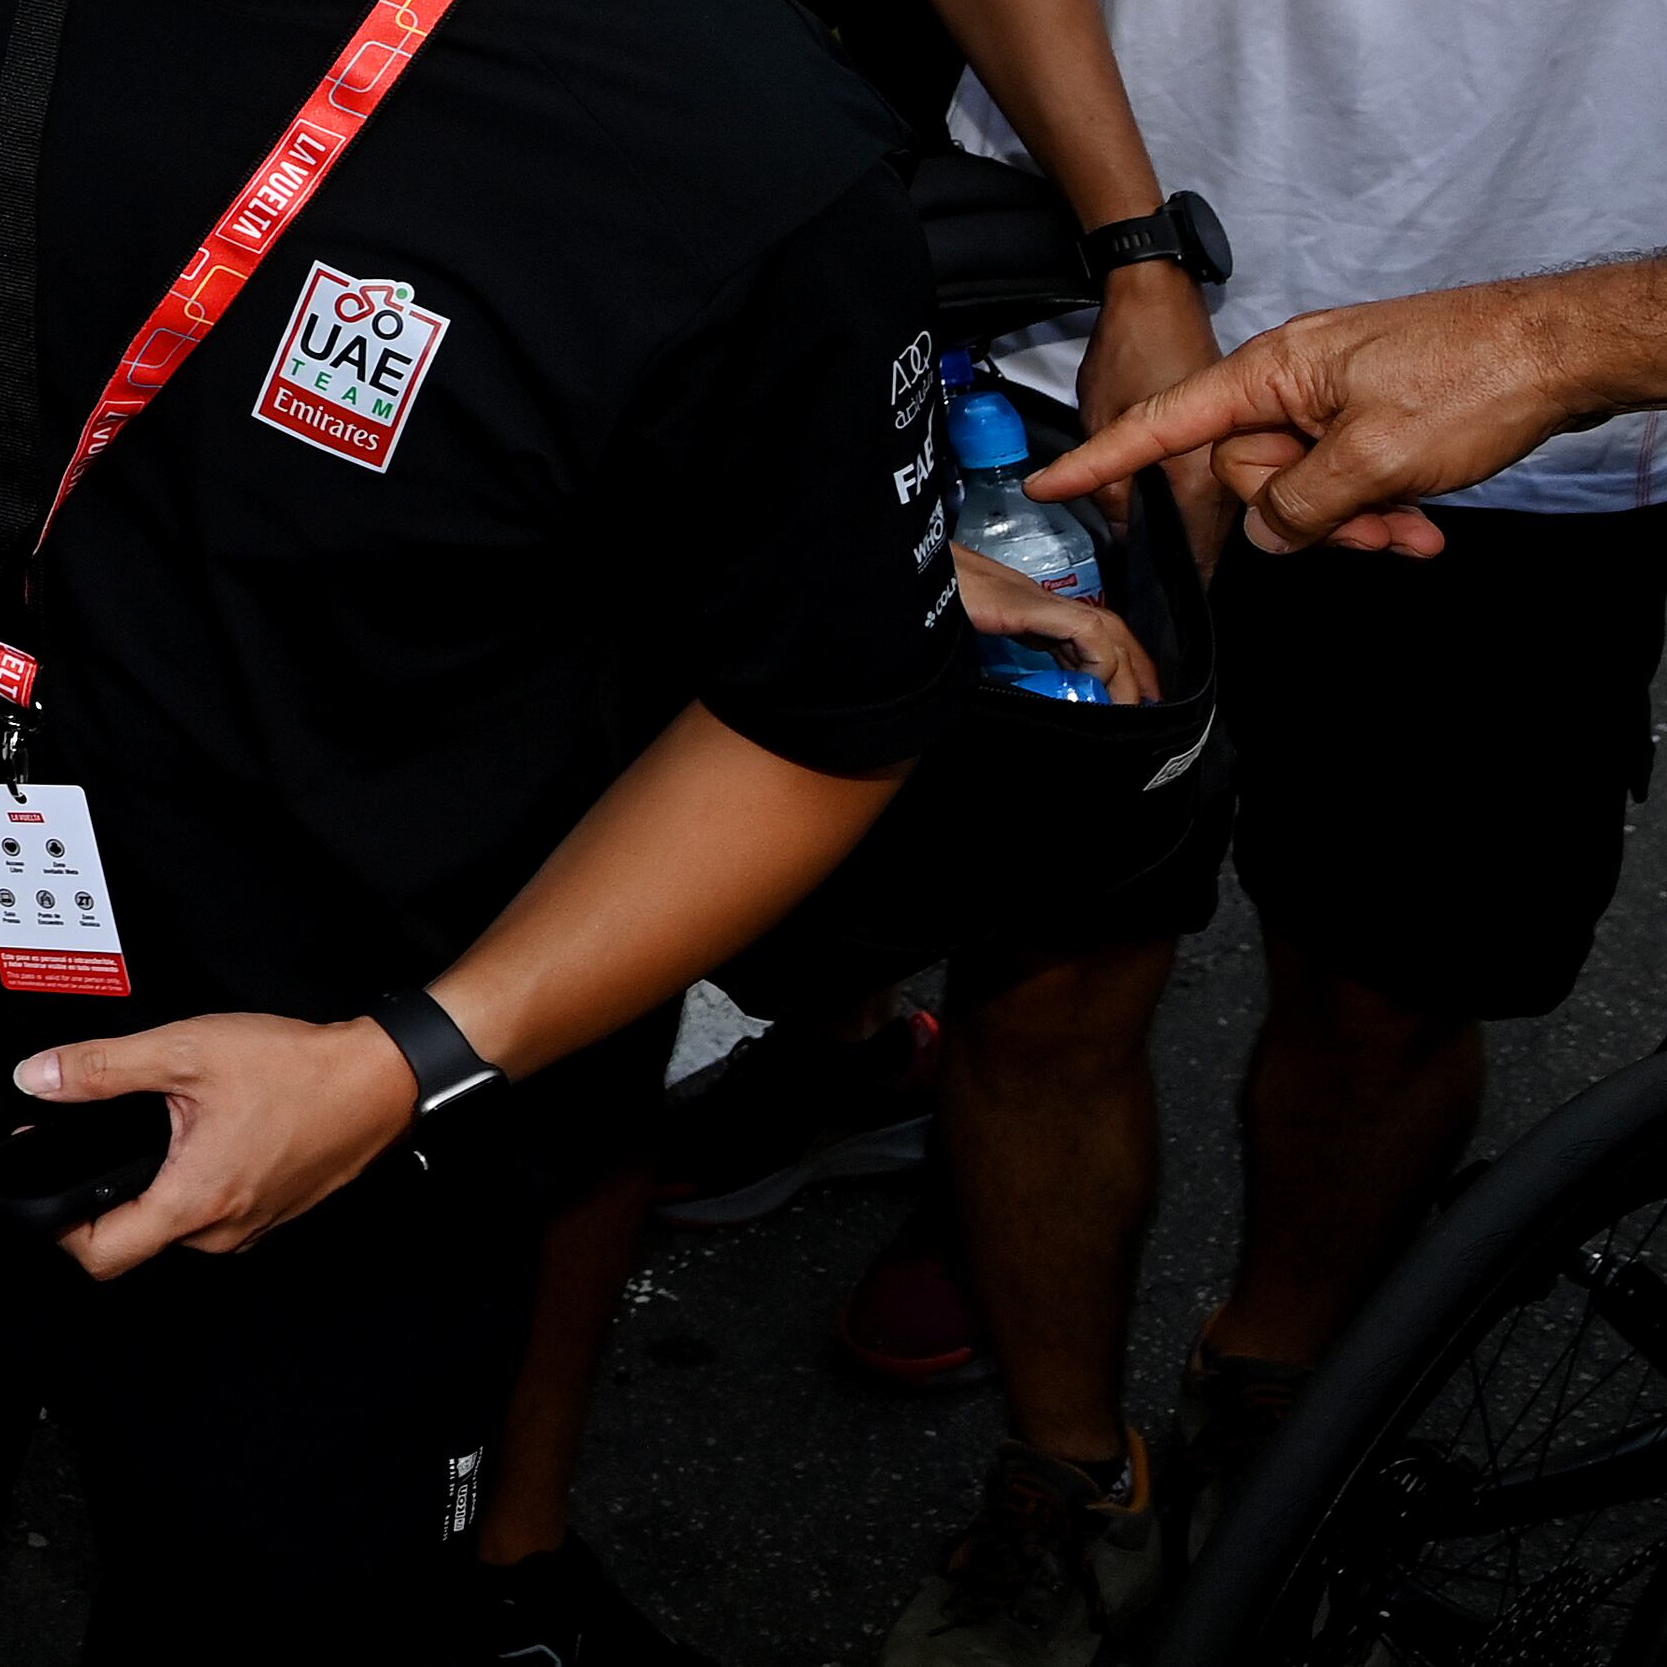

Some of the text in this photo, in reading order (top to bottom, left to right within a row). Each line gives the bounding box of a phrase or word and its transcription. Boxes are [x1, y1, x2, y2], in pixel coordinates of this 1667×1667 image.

[232, 164, 304, 243] VUELTA
[291, 358, 394, 420] TEAM
[301, 314, 413, 397] UAE
[273, 387, 380, 451] Emirates
